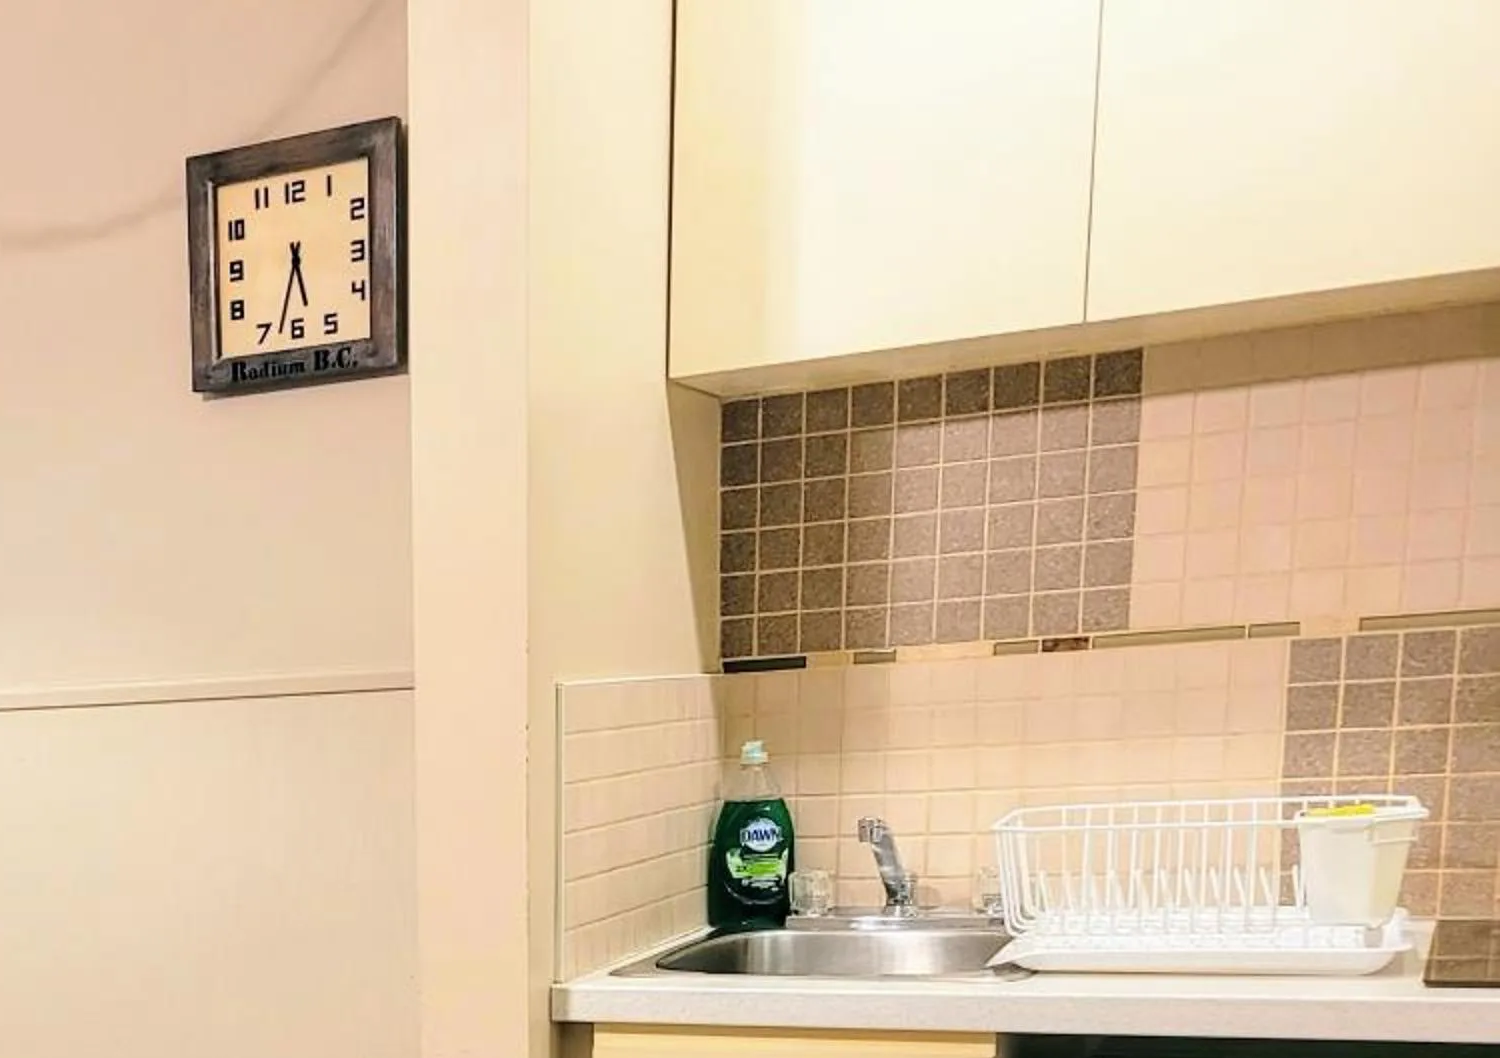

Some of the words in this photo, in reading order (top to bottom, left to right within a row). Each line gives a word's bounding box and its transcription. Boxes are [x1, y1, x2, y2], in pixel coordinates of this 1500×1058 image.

[285, 181, 305, 204] 12
[327, 175, 331, 196] 1
[255, 187, 269, 209] 11
[351, 198, 364, 220] 2
[228, 219, 244, 241] 10
[351, 240, 365, 262] 3
[230, 260, 243, 282] 9
[352, 280, 365, 301] 4
[230, 300, 244, 320] 8
[257, 322, 271, 344] 7
[291, 318, 304, 339] 6
[324, 313, 337, 334] 5
[231, 361, 305, 382] Radium
[313, 348, 358, 371] B.C.
[741, 829, 781, 843] DAWN
